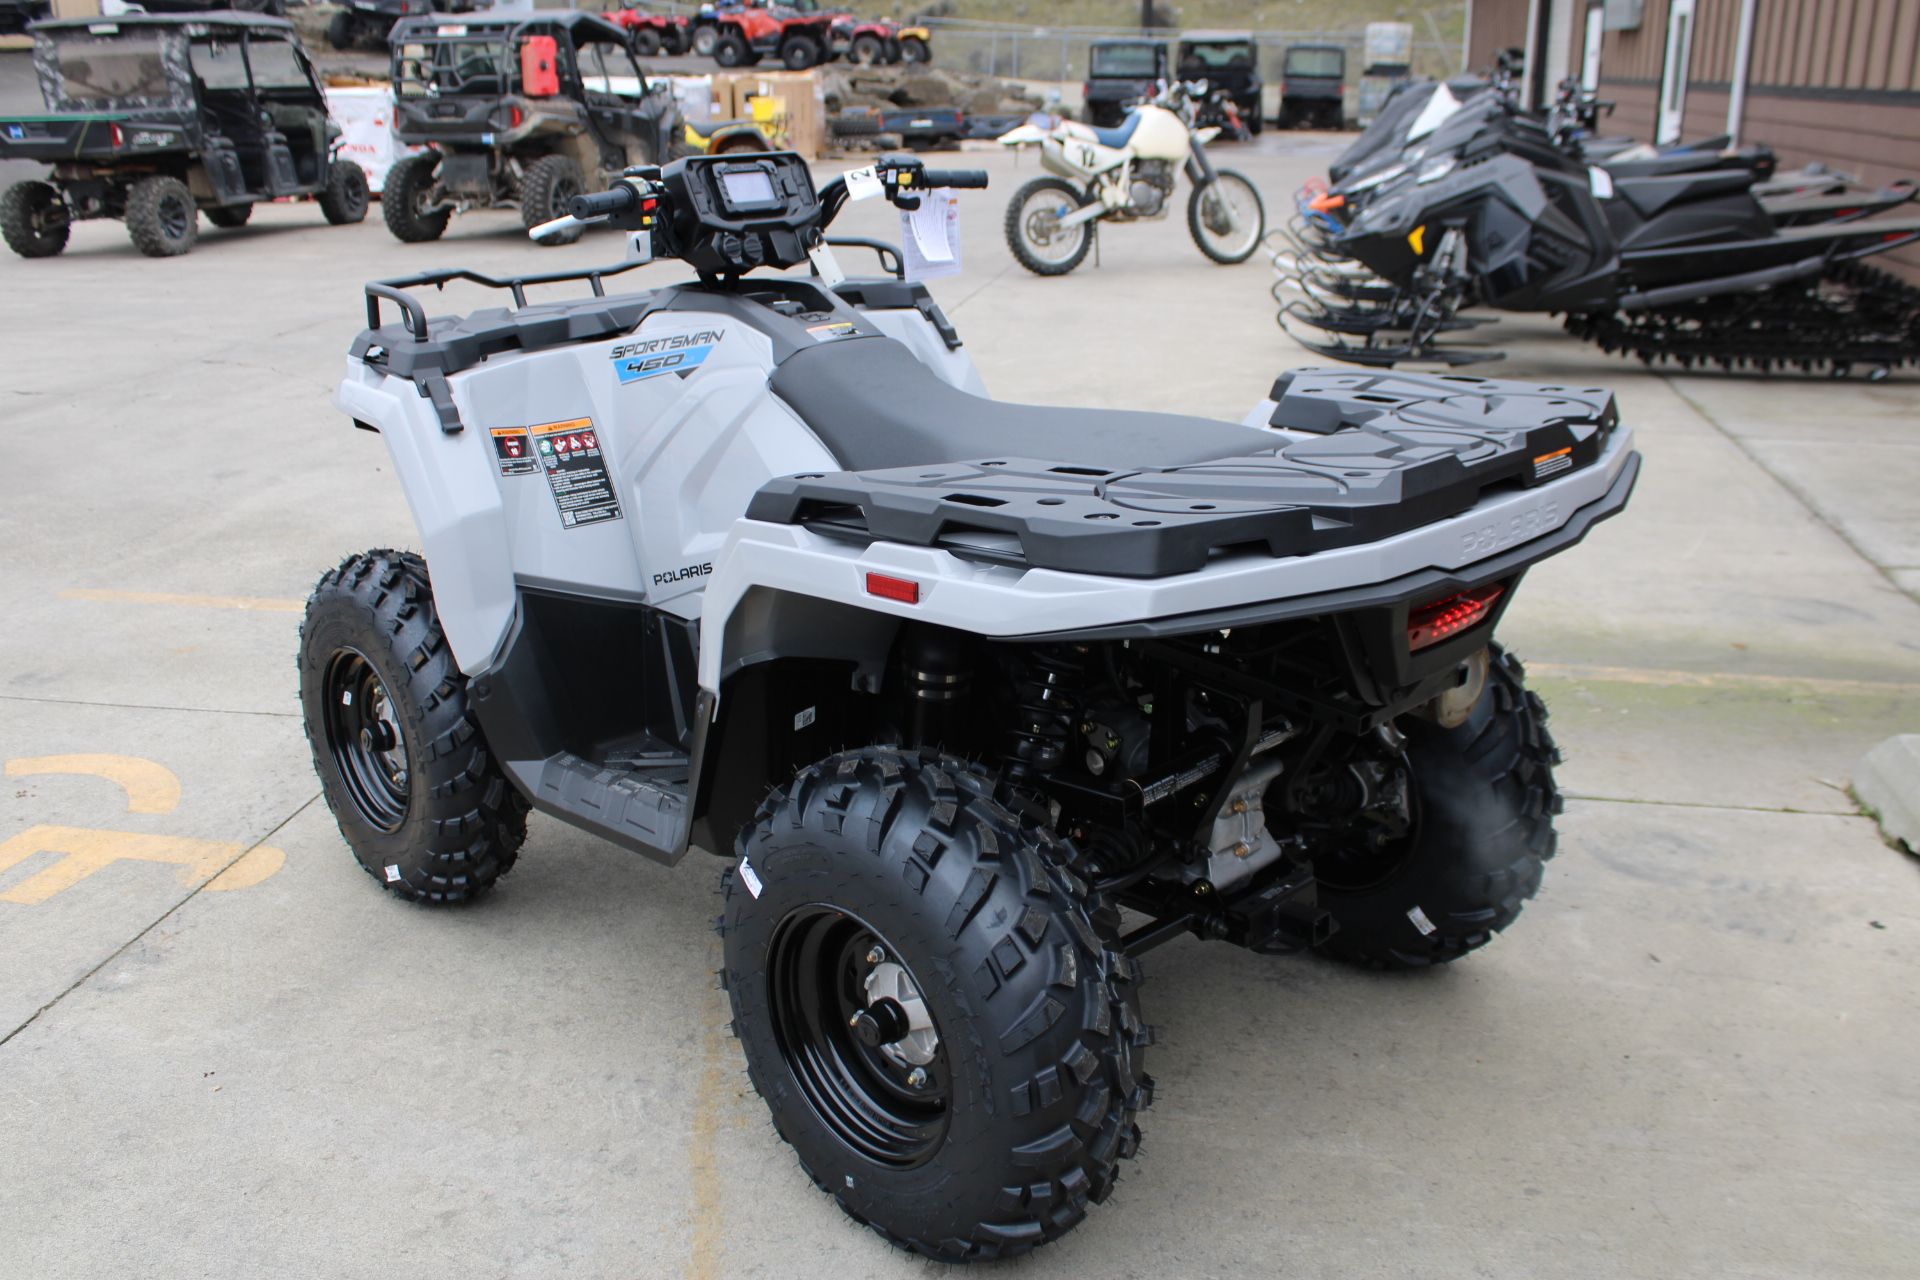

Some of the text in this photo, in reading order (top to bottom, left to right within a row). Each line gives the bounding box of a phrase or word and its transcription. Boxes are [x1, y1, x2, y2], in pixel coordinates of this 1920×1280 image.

[609, 329, 726, 359] SPORTSMAN
[627, 353, 685, 372] 450
[1460, 500, 1560, 554] POLARIS
[653, 562, 713, 586] POLARIS
